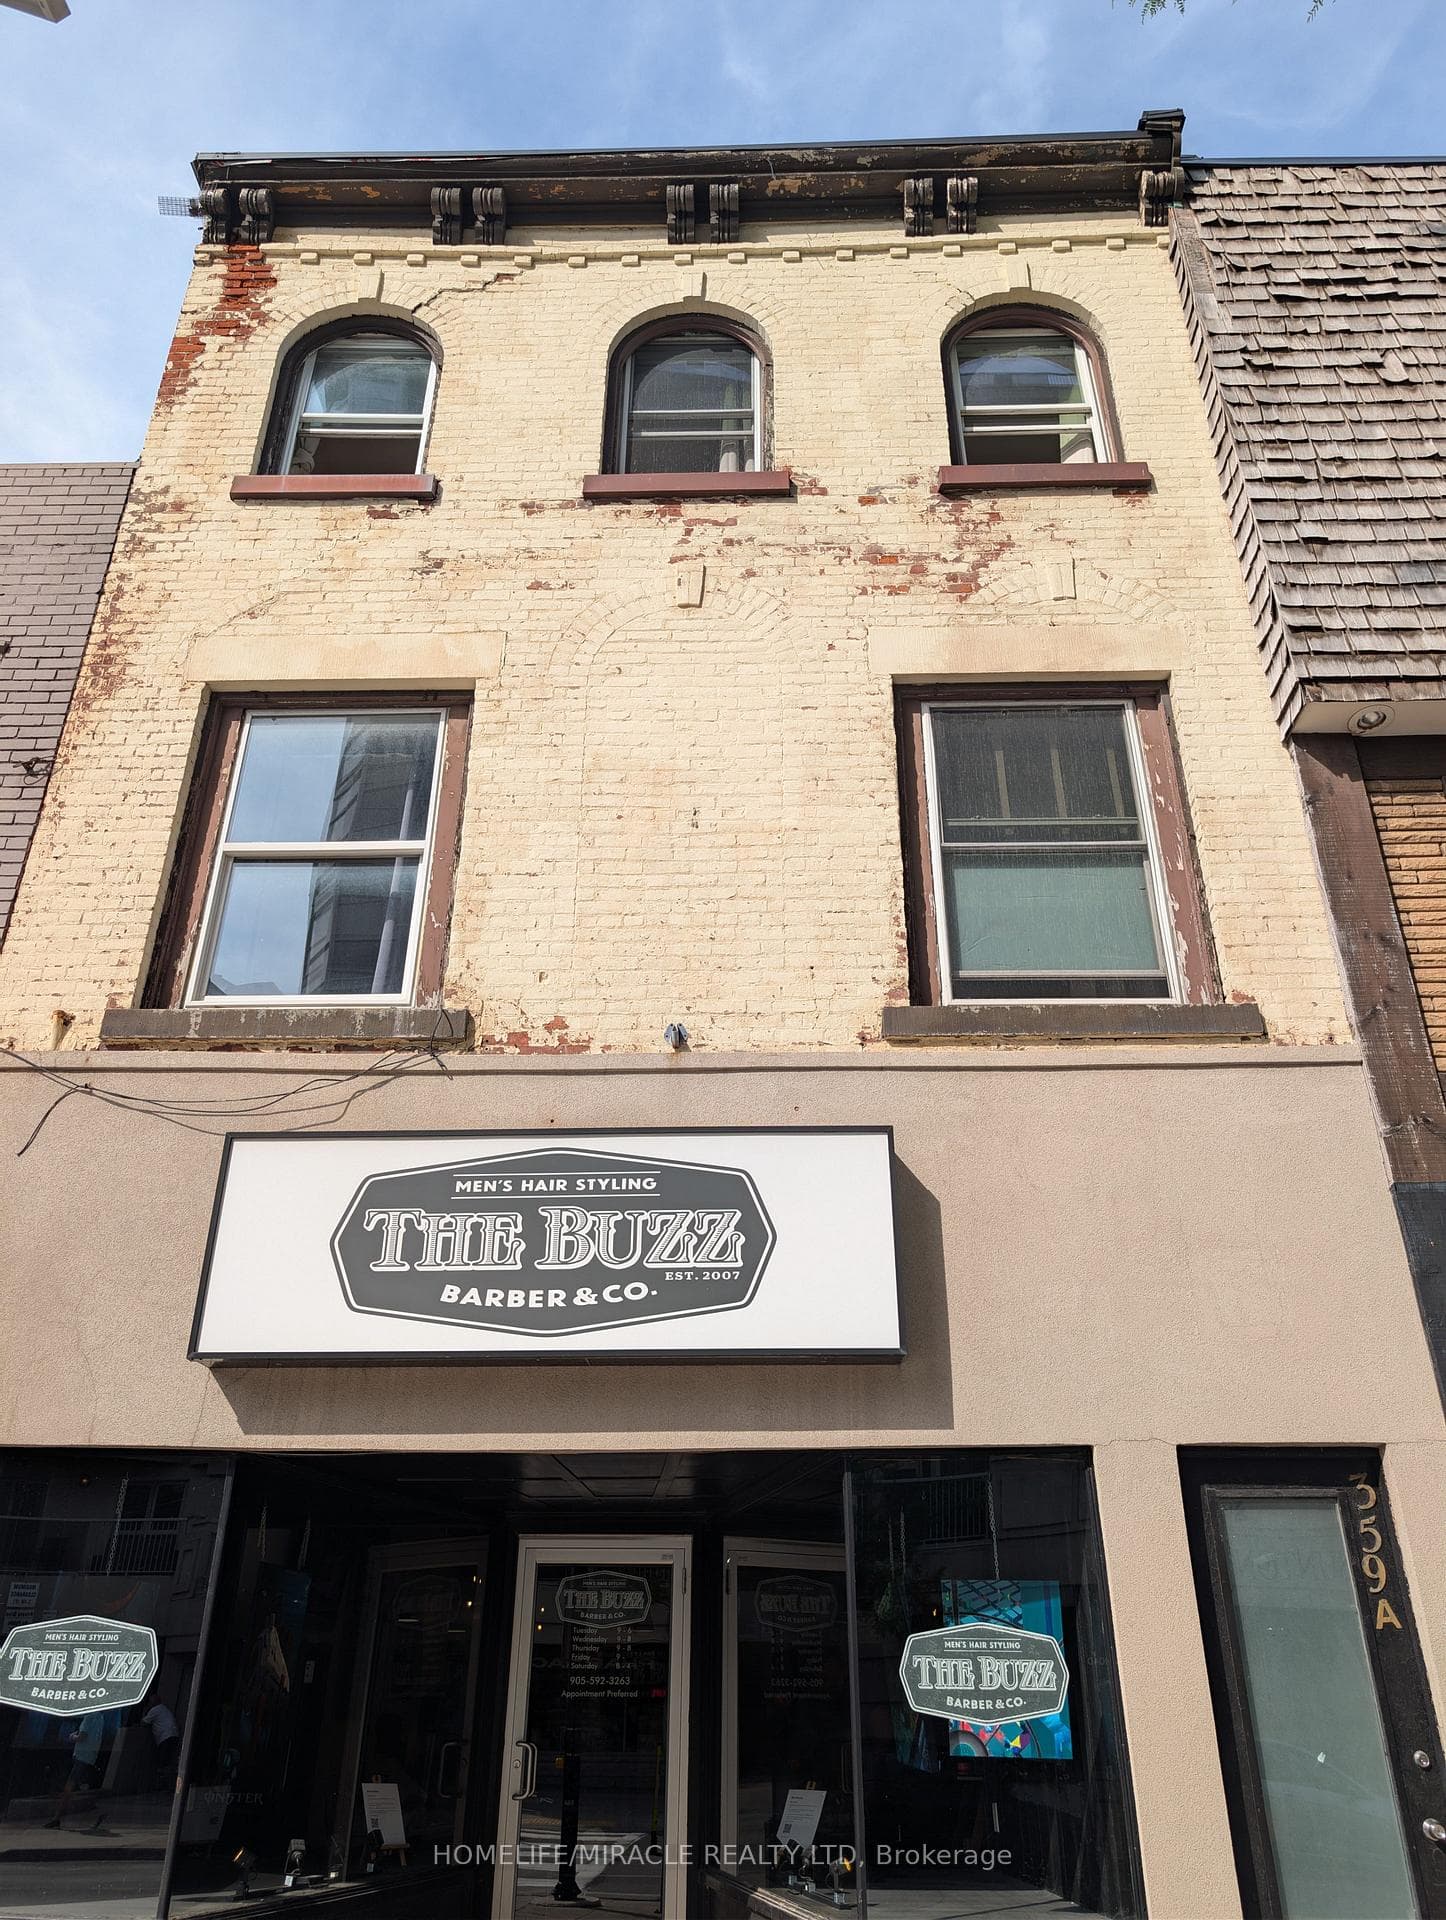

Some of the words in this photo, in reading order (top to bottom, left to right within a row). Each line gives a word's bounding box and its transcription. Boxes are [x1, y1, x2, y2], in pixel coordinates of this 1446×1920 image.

[454, 1178, 512, 1193] MEN'S
[520, 1178, 568, 1192] HAIR
[575, 1176, 657, 1191] STYLING
[364, 1208, 526, 1271] THE
[535, 1205, 744, 1270] BUZZ
[440, 1284, 564, 1309] BARBER
[572, 1289, 598, 1306] &
[602, 1281, 658, 1302] CO.
[563, 1589, 598, 1609] THE
[600, 1588, 645, 1609] BUZZ
[573, 1626, 599, 1634] Tuesday
[45, 1633, 67, 1641] MEN'S
[88, 1634, 119, 1642] STYLING
[572, 1636, 608, 1644] Wednesday
[969, 1641, 987, 1649] HAIR
[989, 1642, 1021, 1650] STYLING
[571, 1653, 591, 1661] Friday
[8, 1647, 67, 1681] THE
[67, 1648, 147, 1682] BUZZ
[570, 1662, 598, 1670] Saturday
[912, 1655, 975, 1690] THE
[977, 1655, 1057, 1691] BUZZ
[569, 1676, 631, 1686] 905-592-3263
[31, 1687, 76, 1700] BARBER
[77, 1689, 88, 1699] &
[88, 1687, 110, 1699] CO.
[561, 1689, 605, 1699] Appointment
[606, 1689, 639, 1698] Preferred
[946, 1696, 993, 1710] BARBER
[995, 1700, 1005, 1709] &
[1005, 1697, 1026, 1708] CO.
